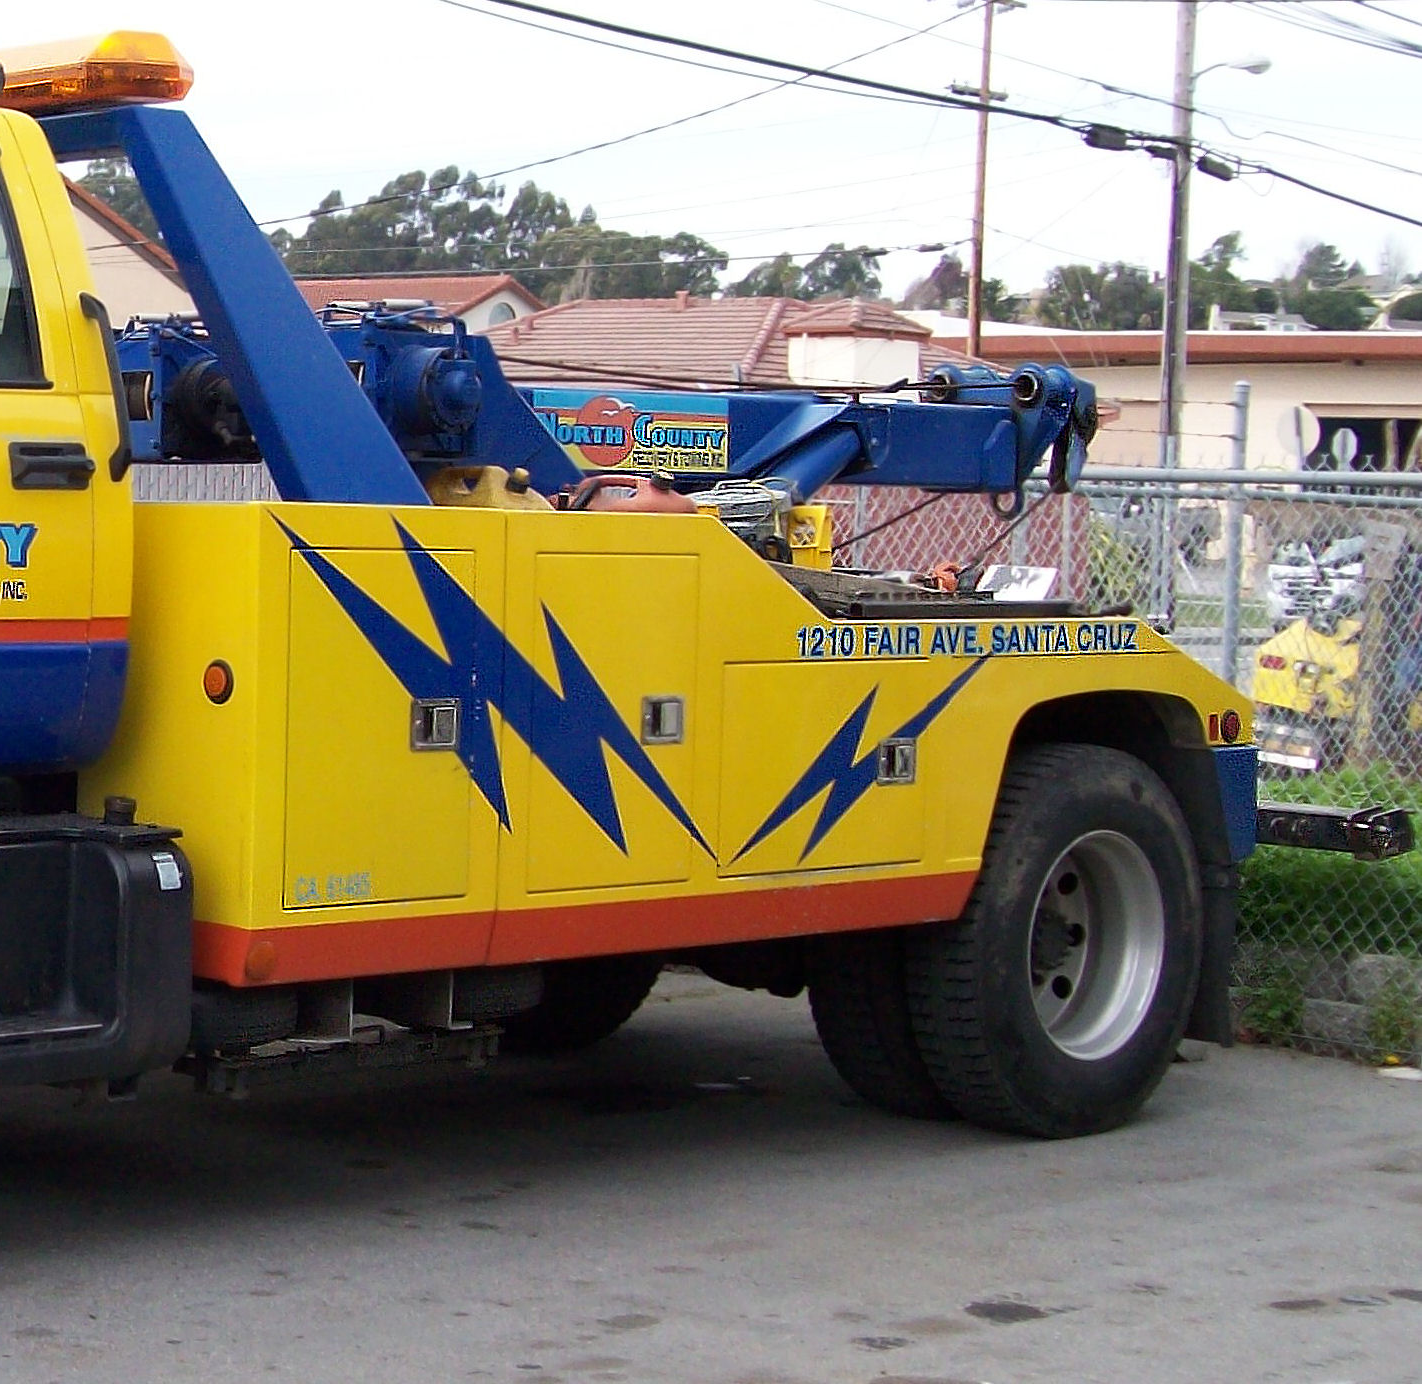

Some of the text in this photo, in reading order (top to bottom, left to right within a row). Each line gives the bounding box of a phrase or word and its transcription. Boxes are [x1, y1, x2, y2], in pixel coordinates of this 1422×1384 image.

[632, 414, 725, 447] COUNTY
[2, 580, 28, 600] INC.
[797, 626, 854, 657] 1210
[864, 626, 919, 655] FAIR
[990, 623, 1069, 653] SANTA
[1077, 623, 1136, 651] CRUZ
